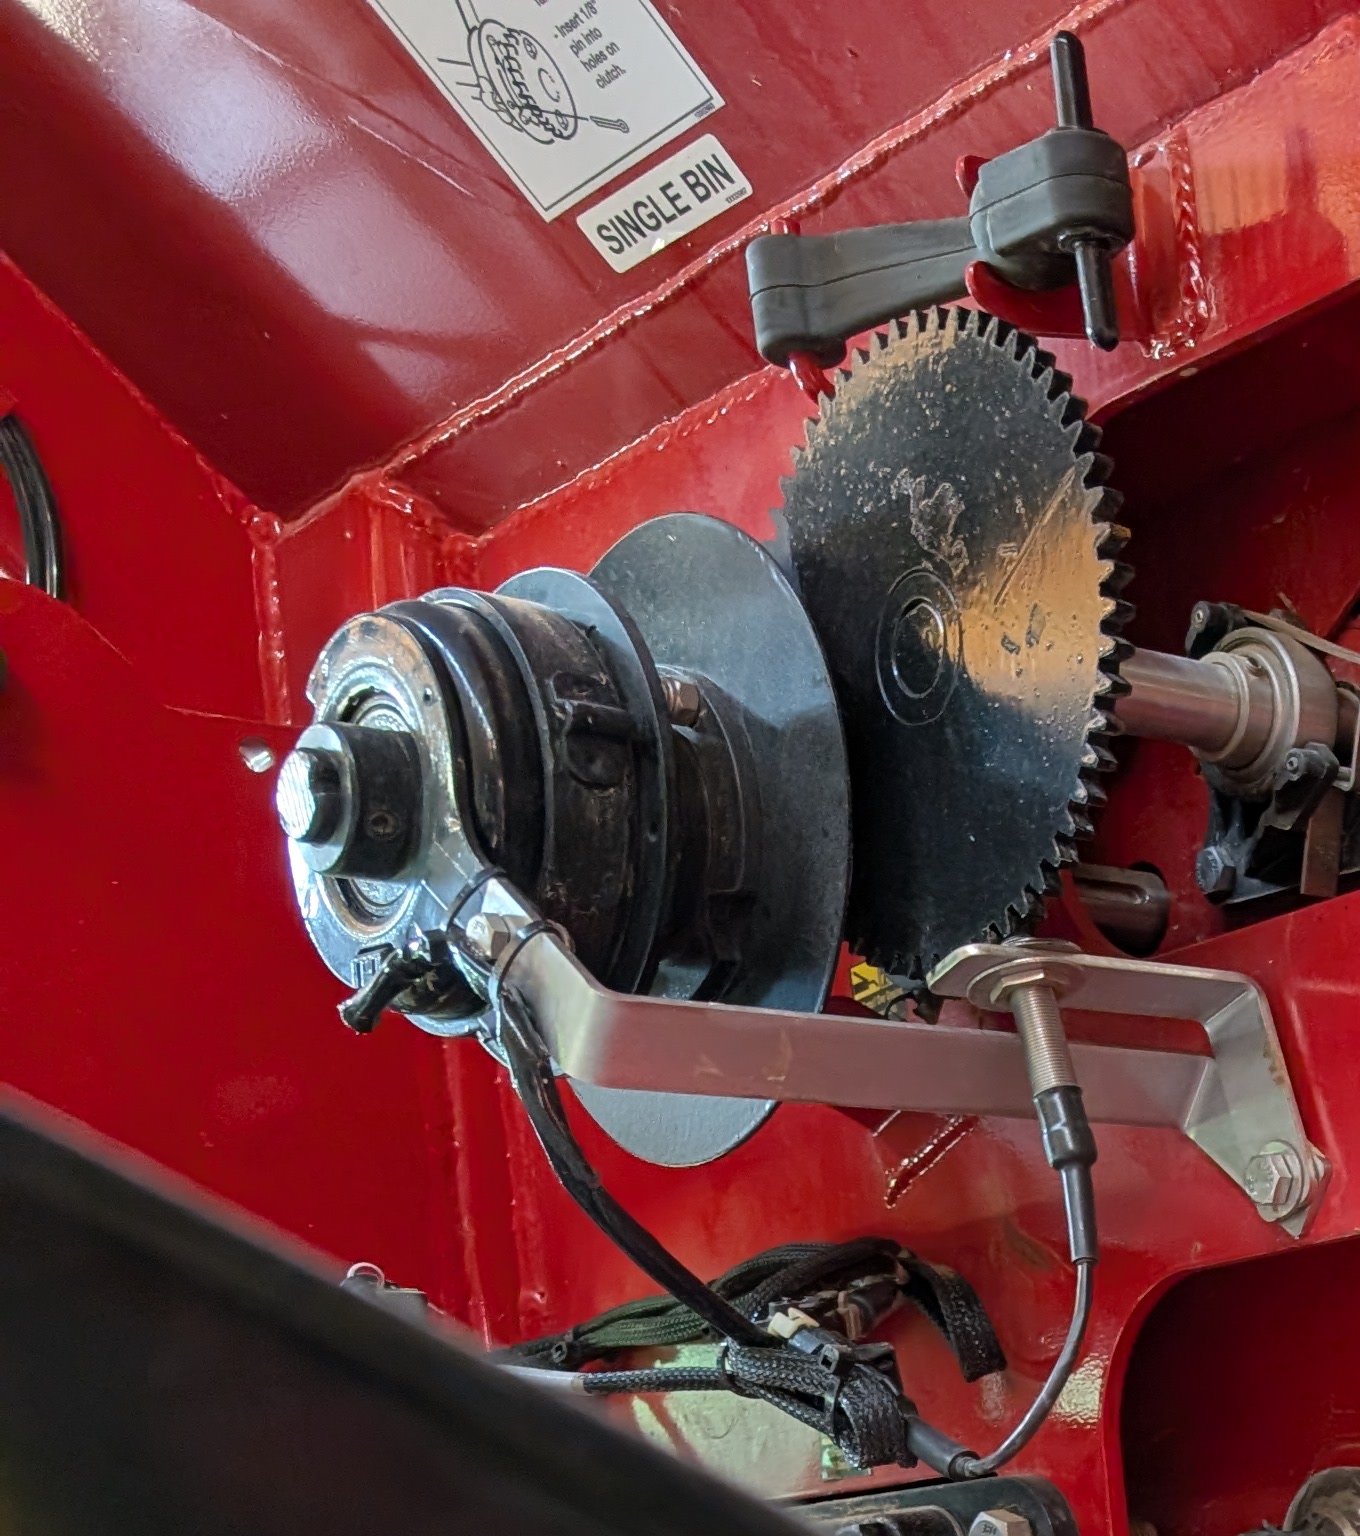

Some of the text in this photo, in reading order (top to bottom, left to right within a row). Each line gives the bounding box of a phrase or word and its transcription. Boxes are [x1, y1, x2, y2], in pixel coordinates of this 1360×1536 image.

[555, 12, 584, 38] Insert
[569, 27, 603, 58] pin into
[580, 41, 620, 73] holes on
[595, 63, 627, 89] clutch.
[596, 153, 736, 255] SINGLE BIN
